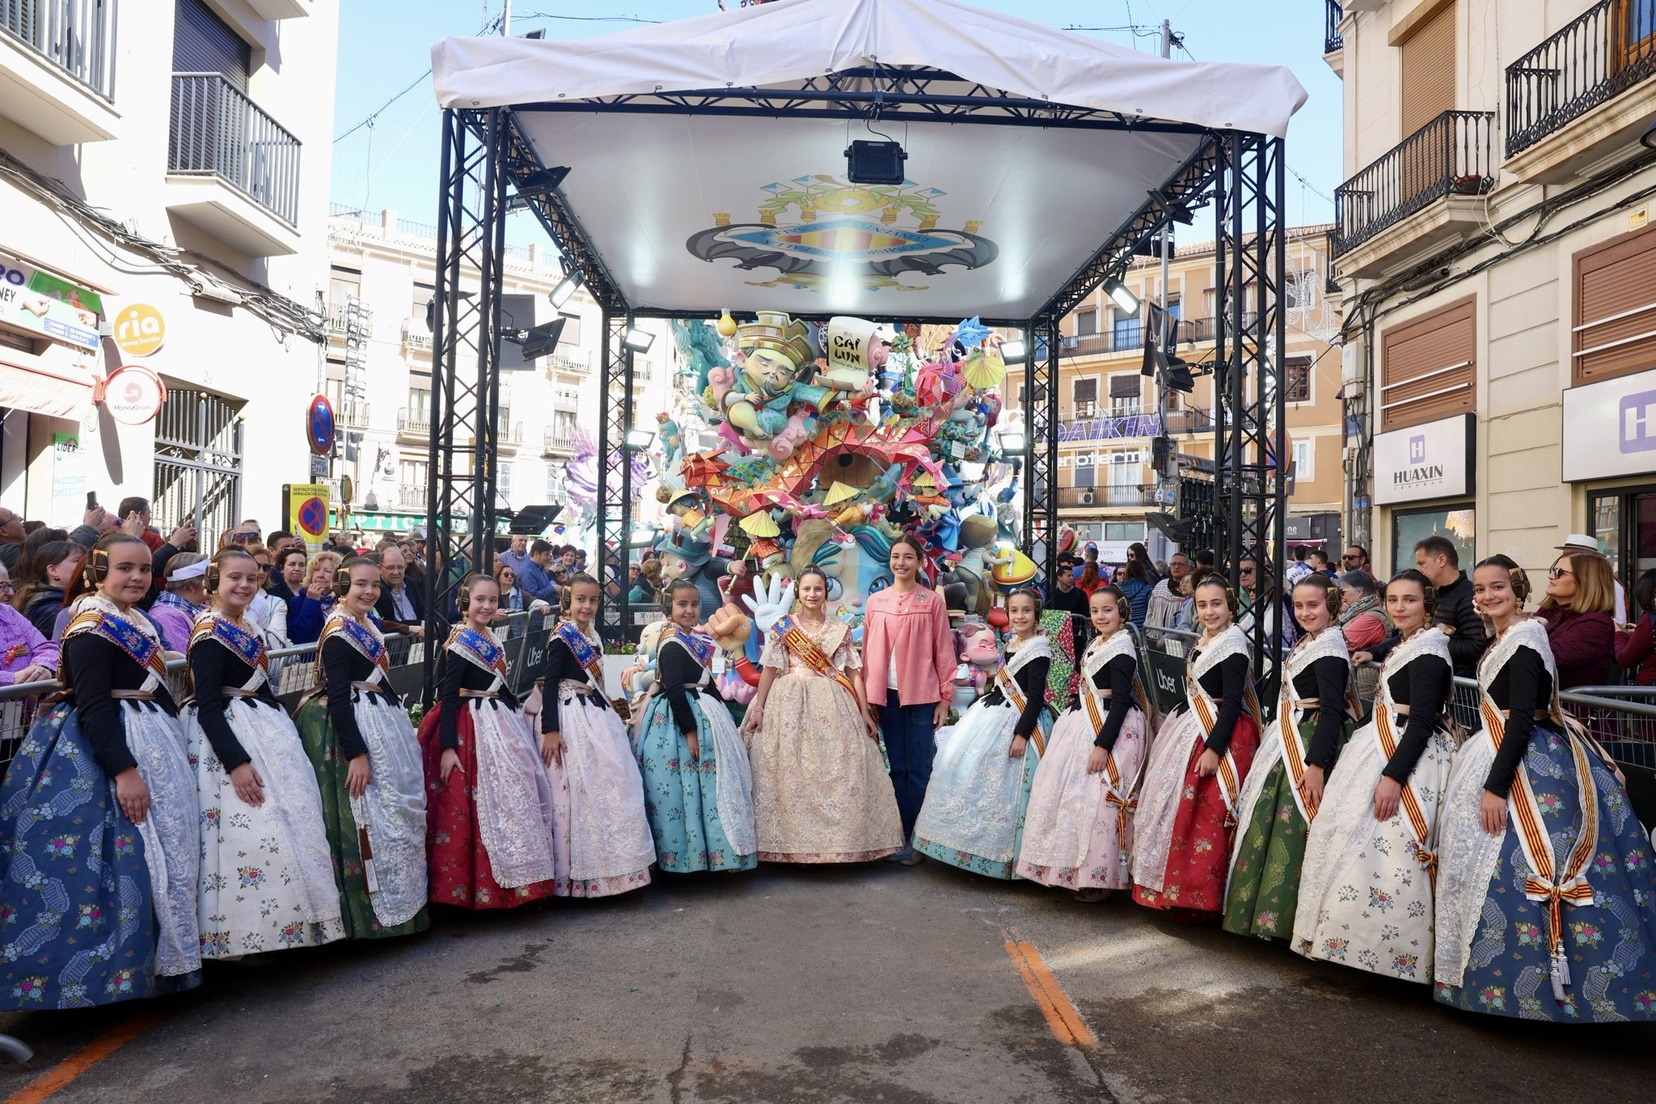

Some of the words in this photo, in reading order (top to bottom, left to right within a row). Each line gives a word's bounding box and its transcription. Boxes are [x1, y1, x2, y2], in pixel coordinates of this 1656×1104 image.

[118, 310, 160, 340] ria
[113, 404, 152, 412] MoneyGram
[1393, 464, 1443, 484] HUAXIN
[527, 646, 544, 668] Uber
[1154, 667, 1176, 694] Uber
